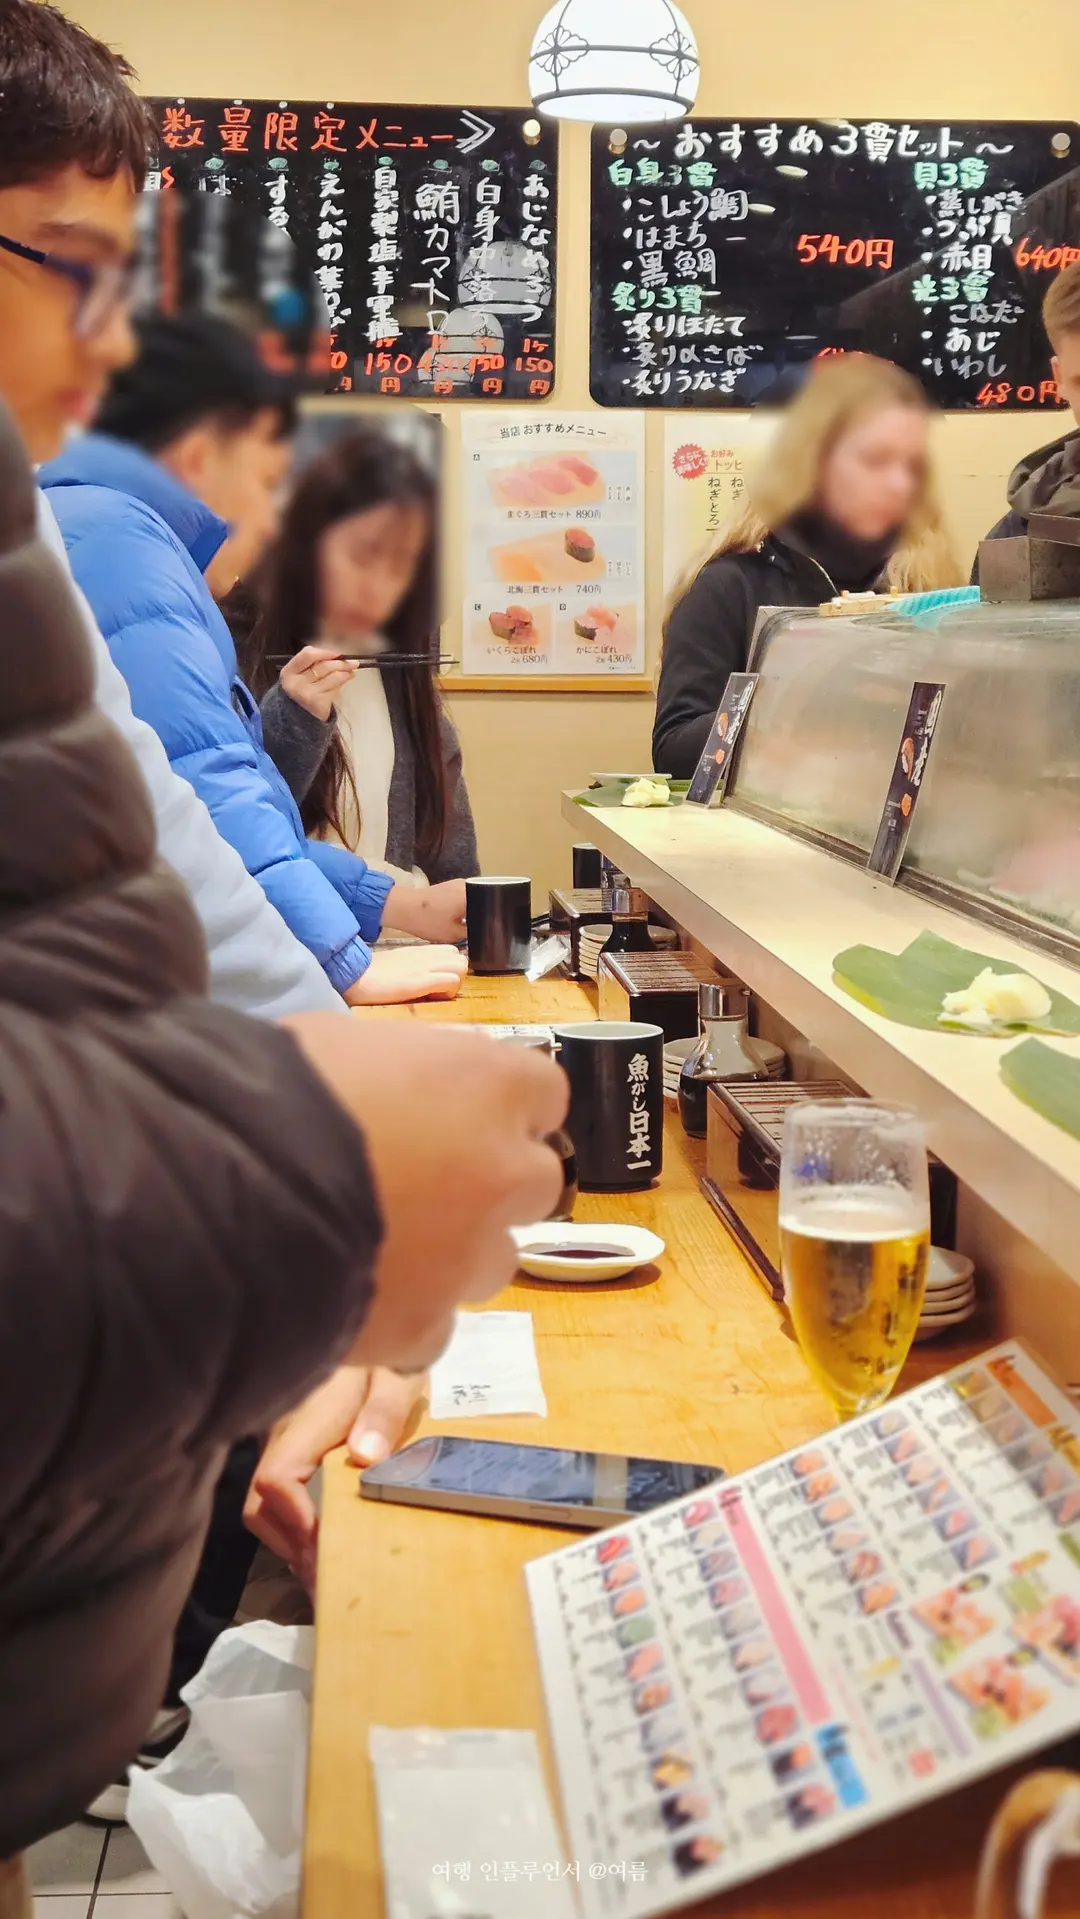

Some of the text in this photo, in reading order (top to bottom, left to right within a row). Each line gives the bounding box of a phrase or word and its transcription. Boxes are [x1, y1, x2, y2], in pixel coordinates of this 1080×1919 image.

[162, 107, 454, 152] 数量限定メニュー
[521, 173, 552, 323] あじなめろう
[797, 233, 895, 270] 540円
[363, 351, 413, 376] 150
[515, 356, 554, 374] 150
[626, 1053, 652, 1171] 魚がし日本一
